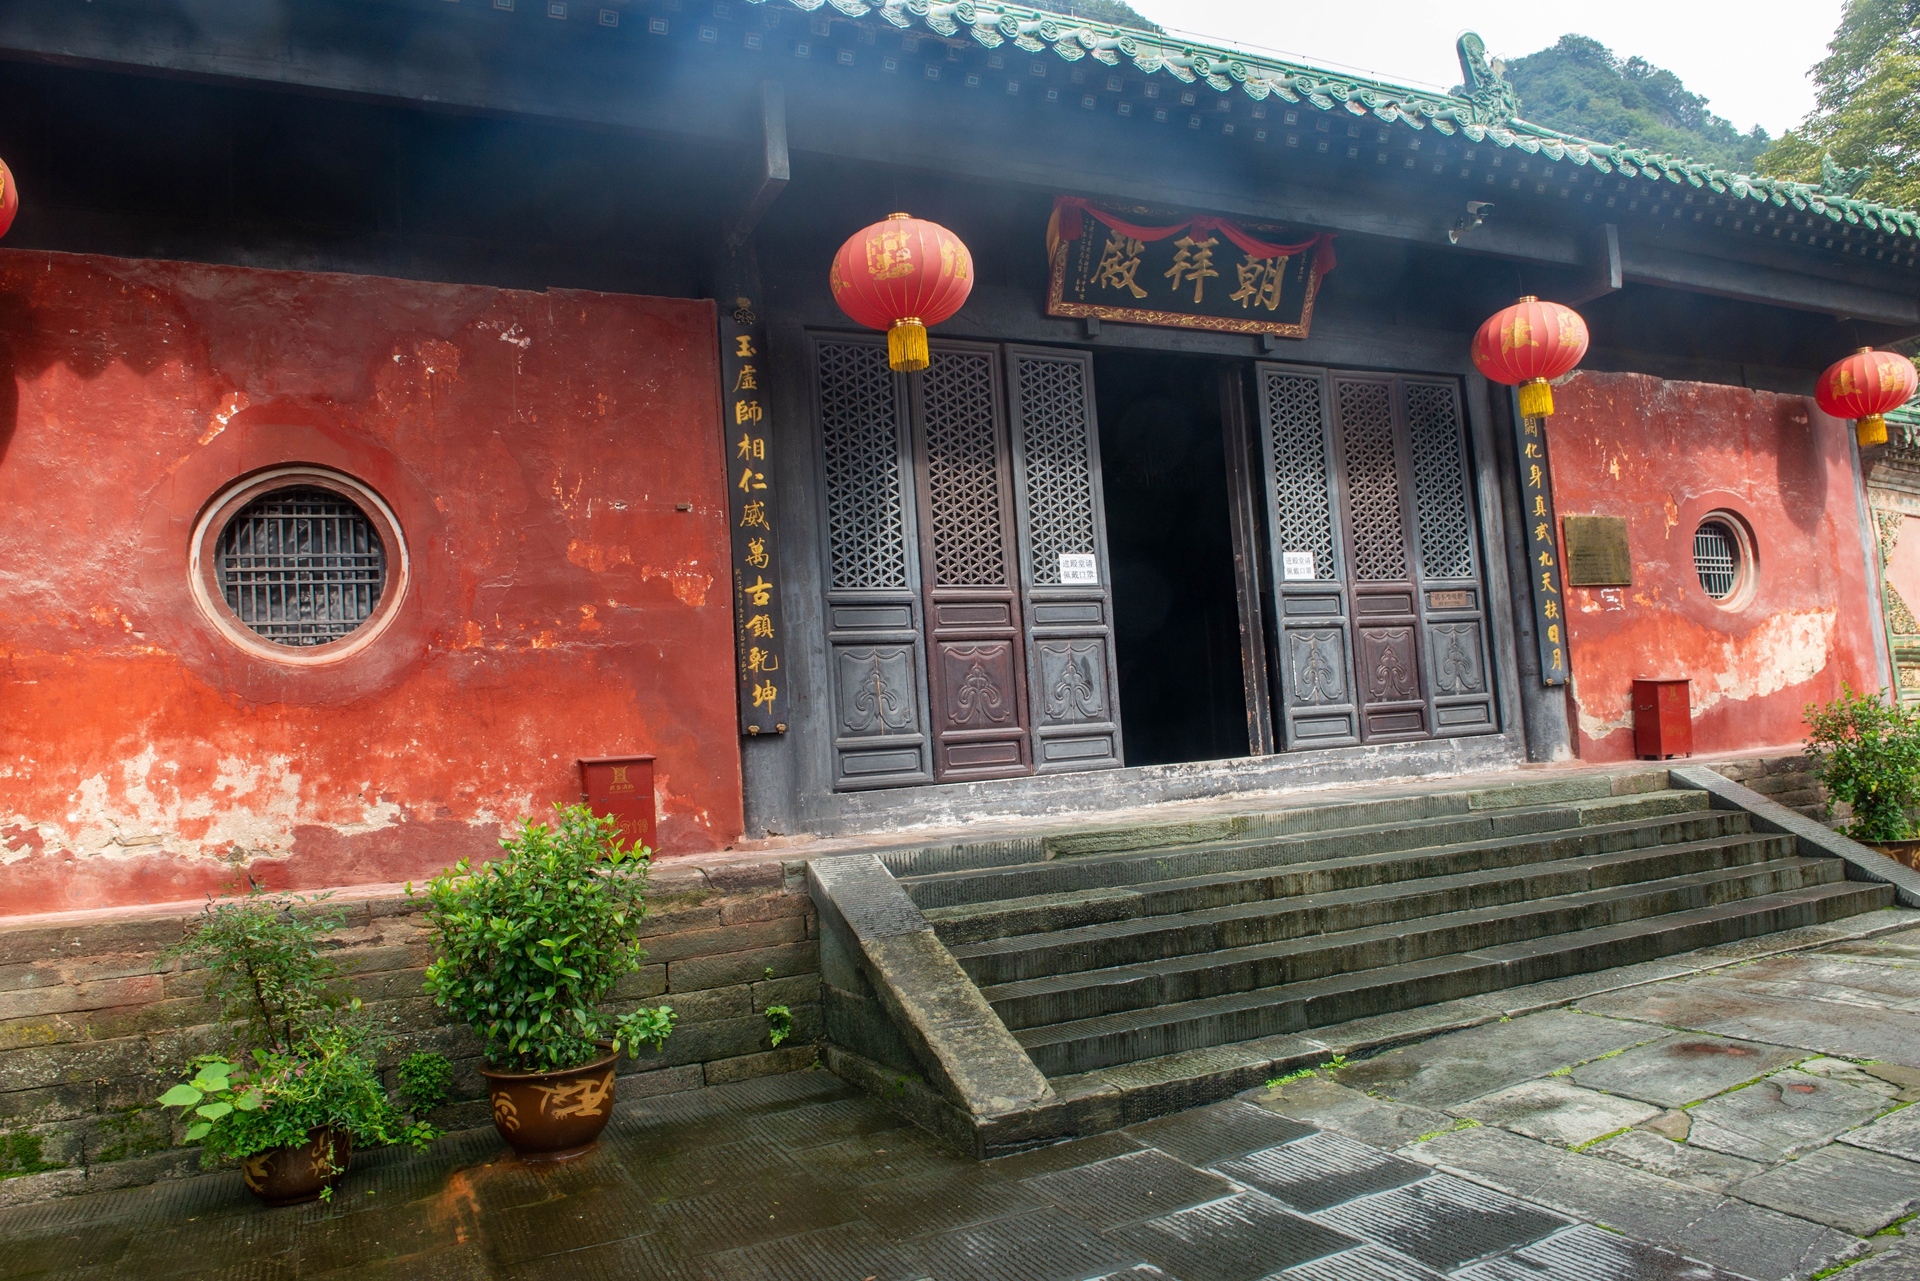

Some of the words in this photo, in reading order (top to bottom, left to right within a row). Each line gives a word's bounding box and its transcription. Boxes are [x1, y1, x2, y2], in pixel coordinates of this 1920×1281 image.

[1090, 228, 1290, 312] 朝拜殿
[632, 818, 649, 834] 119
